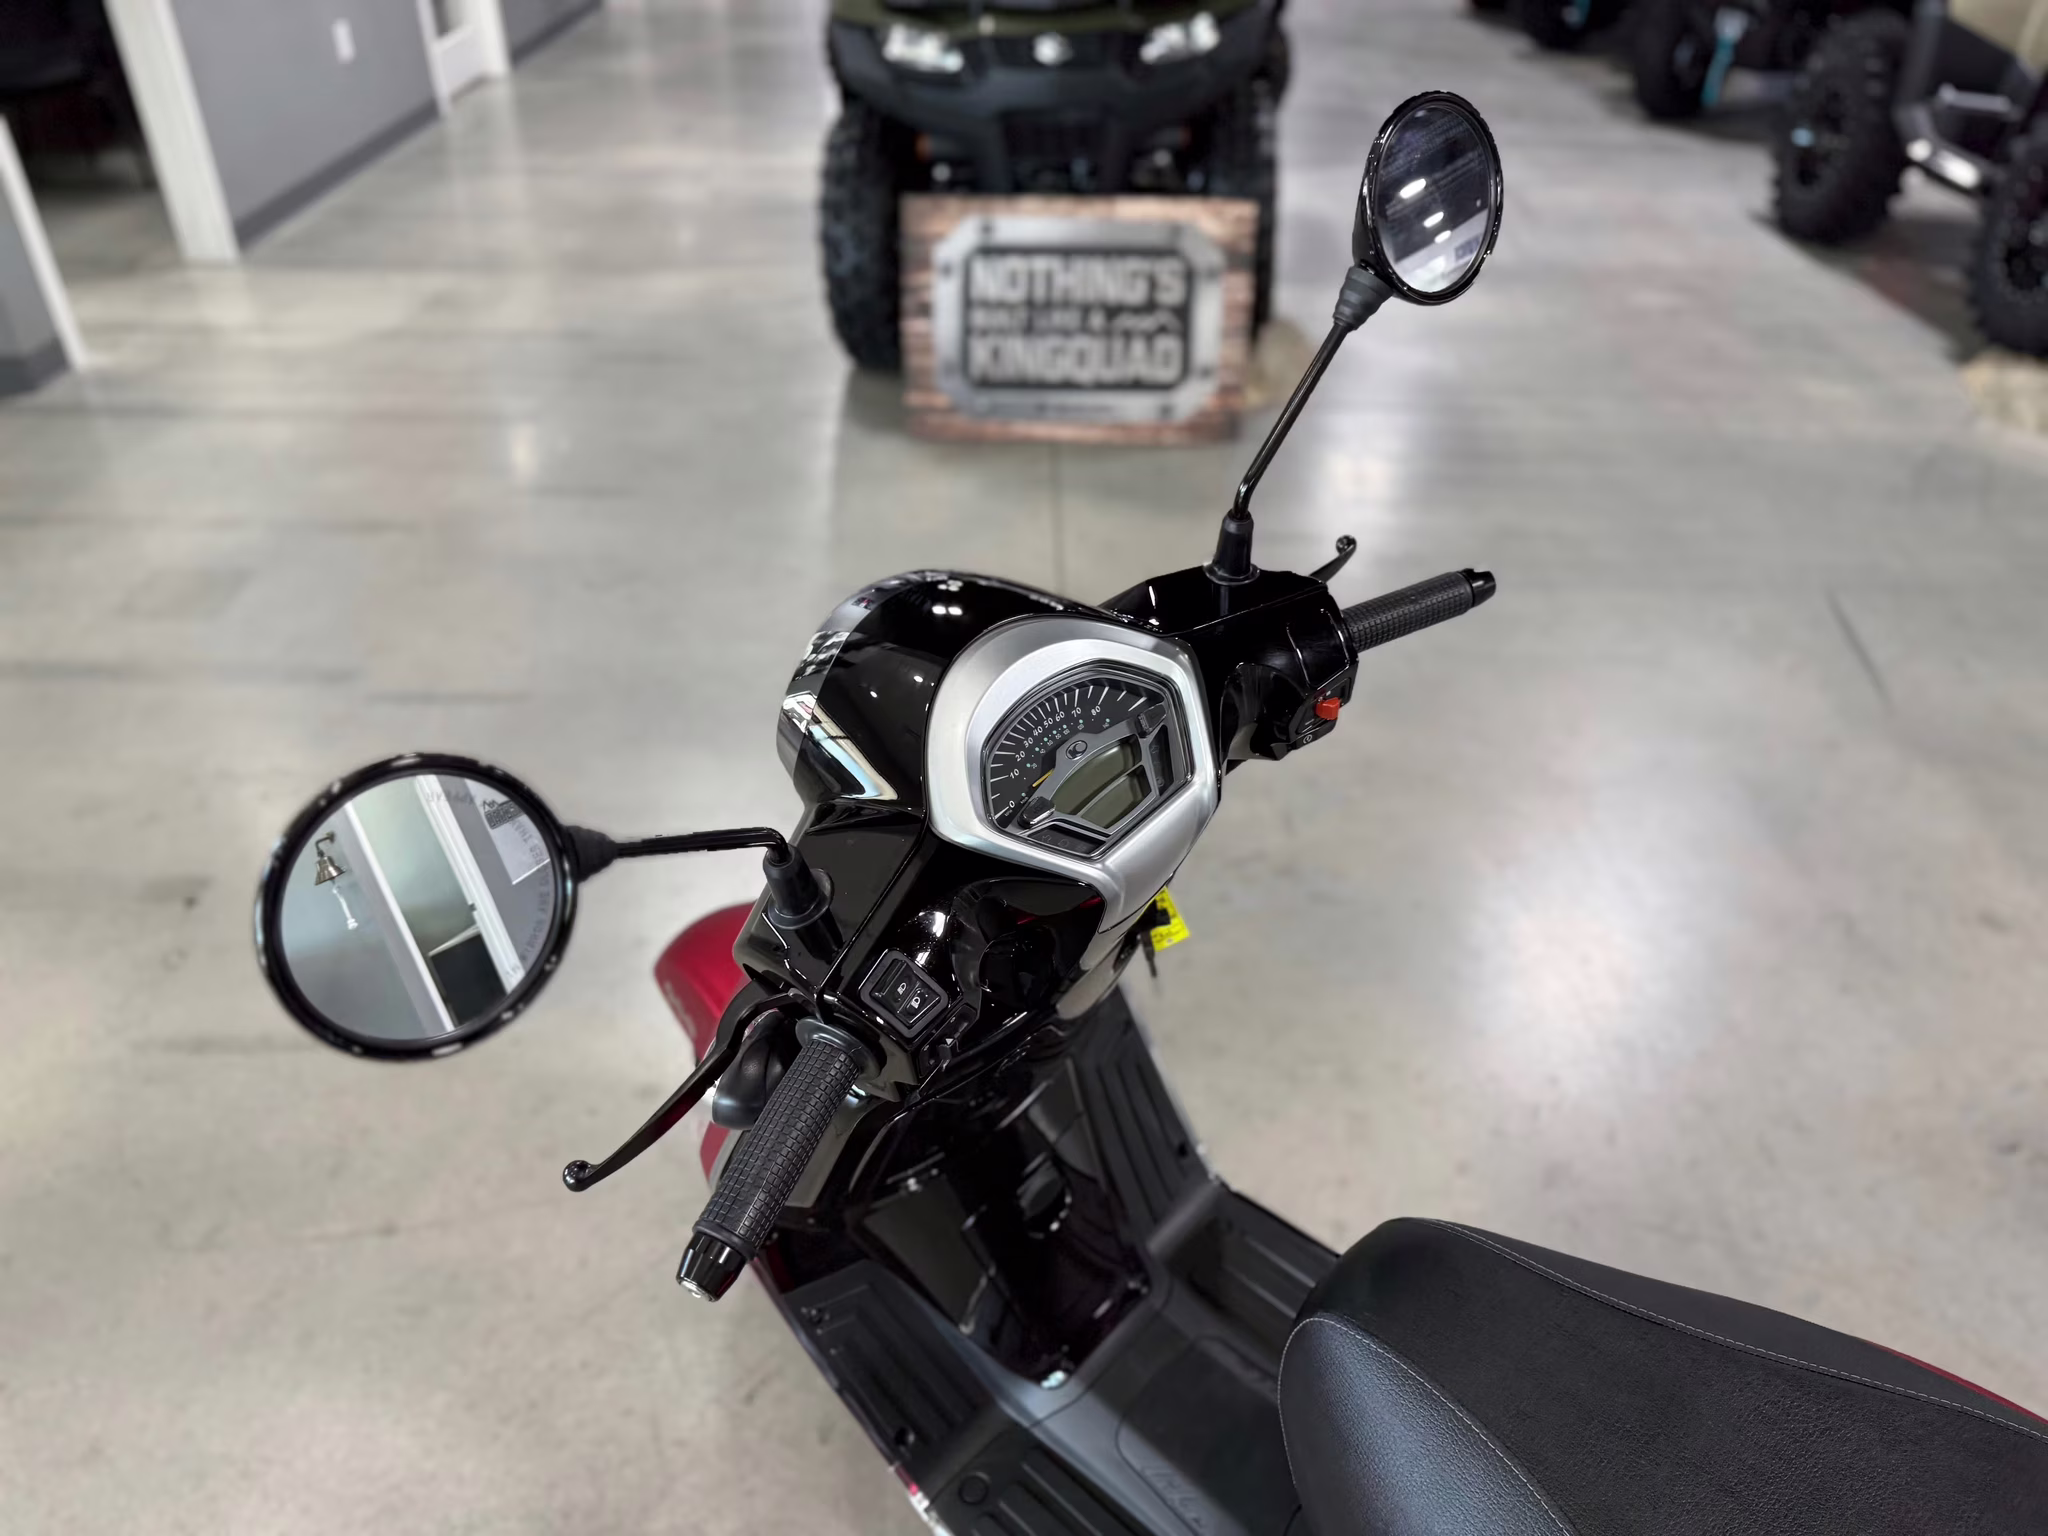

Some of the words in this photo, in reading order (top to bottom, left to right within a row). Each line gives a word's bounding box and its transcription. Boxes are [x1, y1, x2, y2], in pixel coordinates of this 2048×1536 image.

[969, 254, 1186, 305] NOTHING'S
[969, 335, 1183, 386] KINGQUAD
[1055, 711, 1065, 722] 60
[1072, 708, 1082, 717] 70
[1091, 706, 1100, 715] 80
[1043, 717, 1054, 728] 50
[1032, 725, 1043, 737] 40
[1023, 736, 1034, 748] 30
[1015, 750, 1026, 762] 20
[1009, 768, 1020, 780] 10
[1009, 800, 1015, 808] 0
